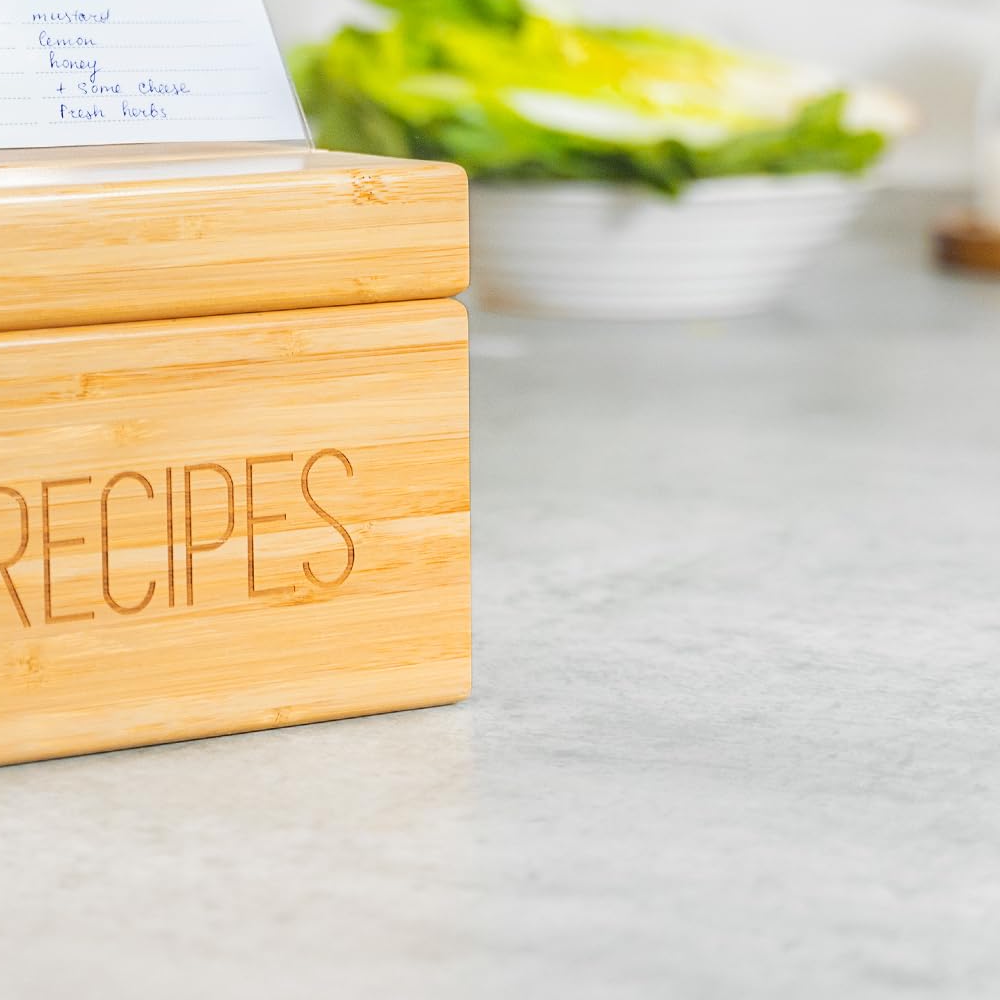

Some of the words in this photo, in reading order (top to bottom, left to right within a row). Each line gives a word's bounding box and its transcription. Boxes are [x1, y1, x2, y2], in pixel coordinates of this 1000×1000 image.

[32, 9, 110, 24] mustard
[38, 30, 97, 47] lemon
[49, 50, 103, 83] honey
[121, 99, 168, 118] herbs
